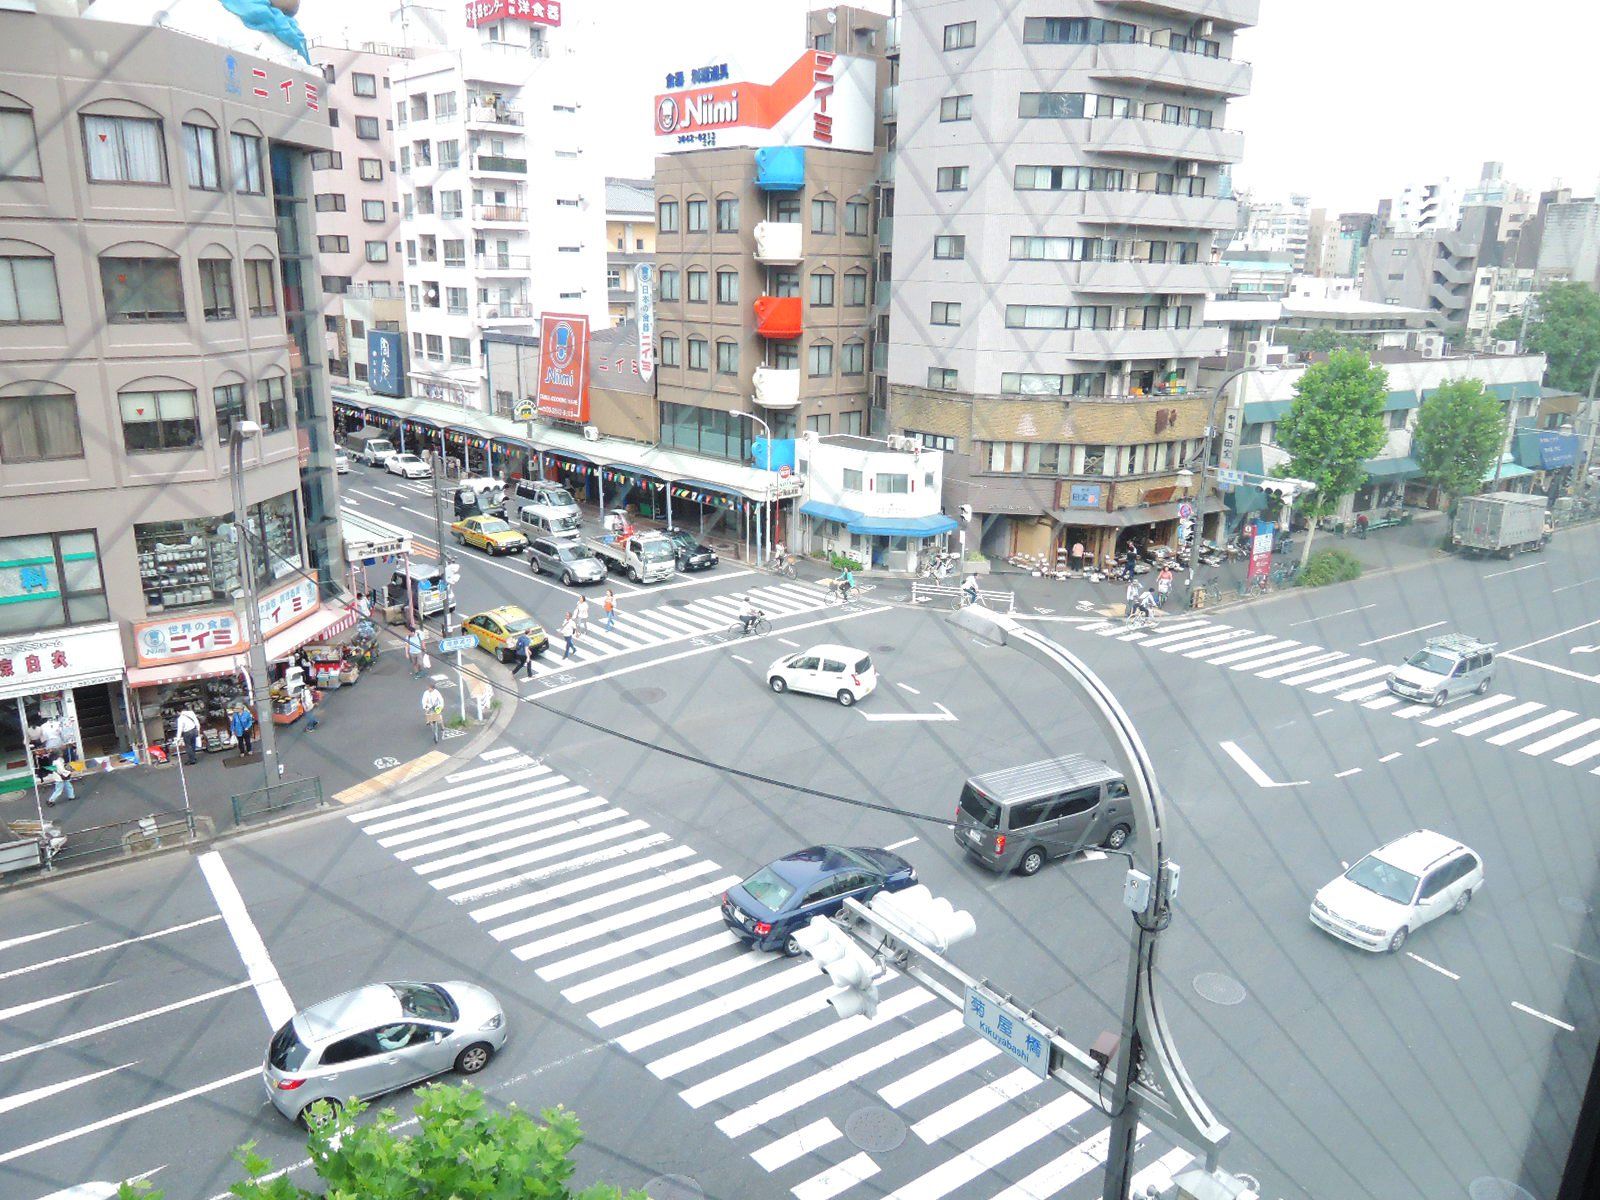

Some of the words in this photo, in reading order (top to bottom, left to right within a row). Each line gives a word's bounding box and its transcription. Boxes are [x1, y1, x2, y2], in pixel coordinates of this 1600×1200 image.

[252, 68, 319, 112] ニイミ
[680, 90, 738, 128] Niimi
[813, 53, 834, 144] ニイミ
[168, 618, 230, 634] 世界の食器
[170, 629, 232, 652] ニイミ
[970, 995, 1041, 1058] 菊屋橋
[980, 1021, 1029, 1062] Kikuyabashi
